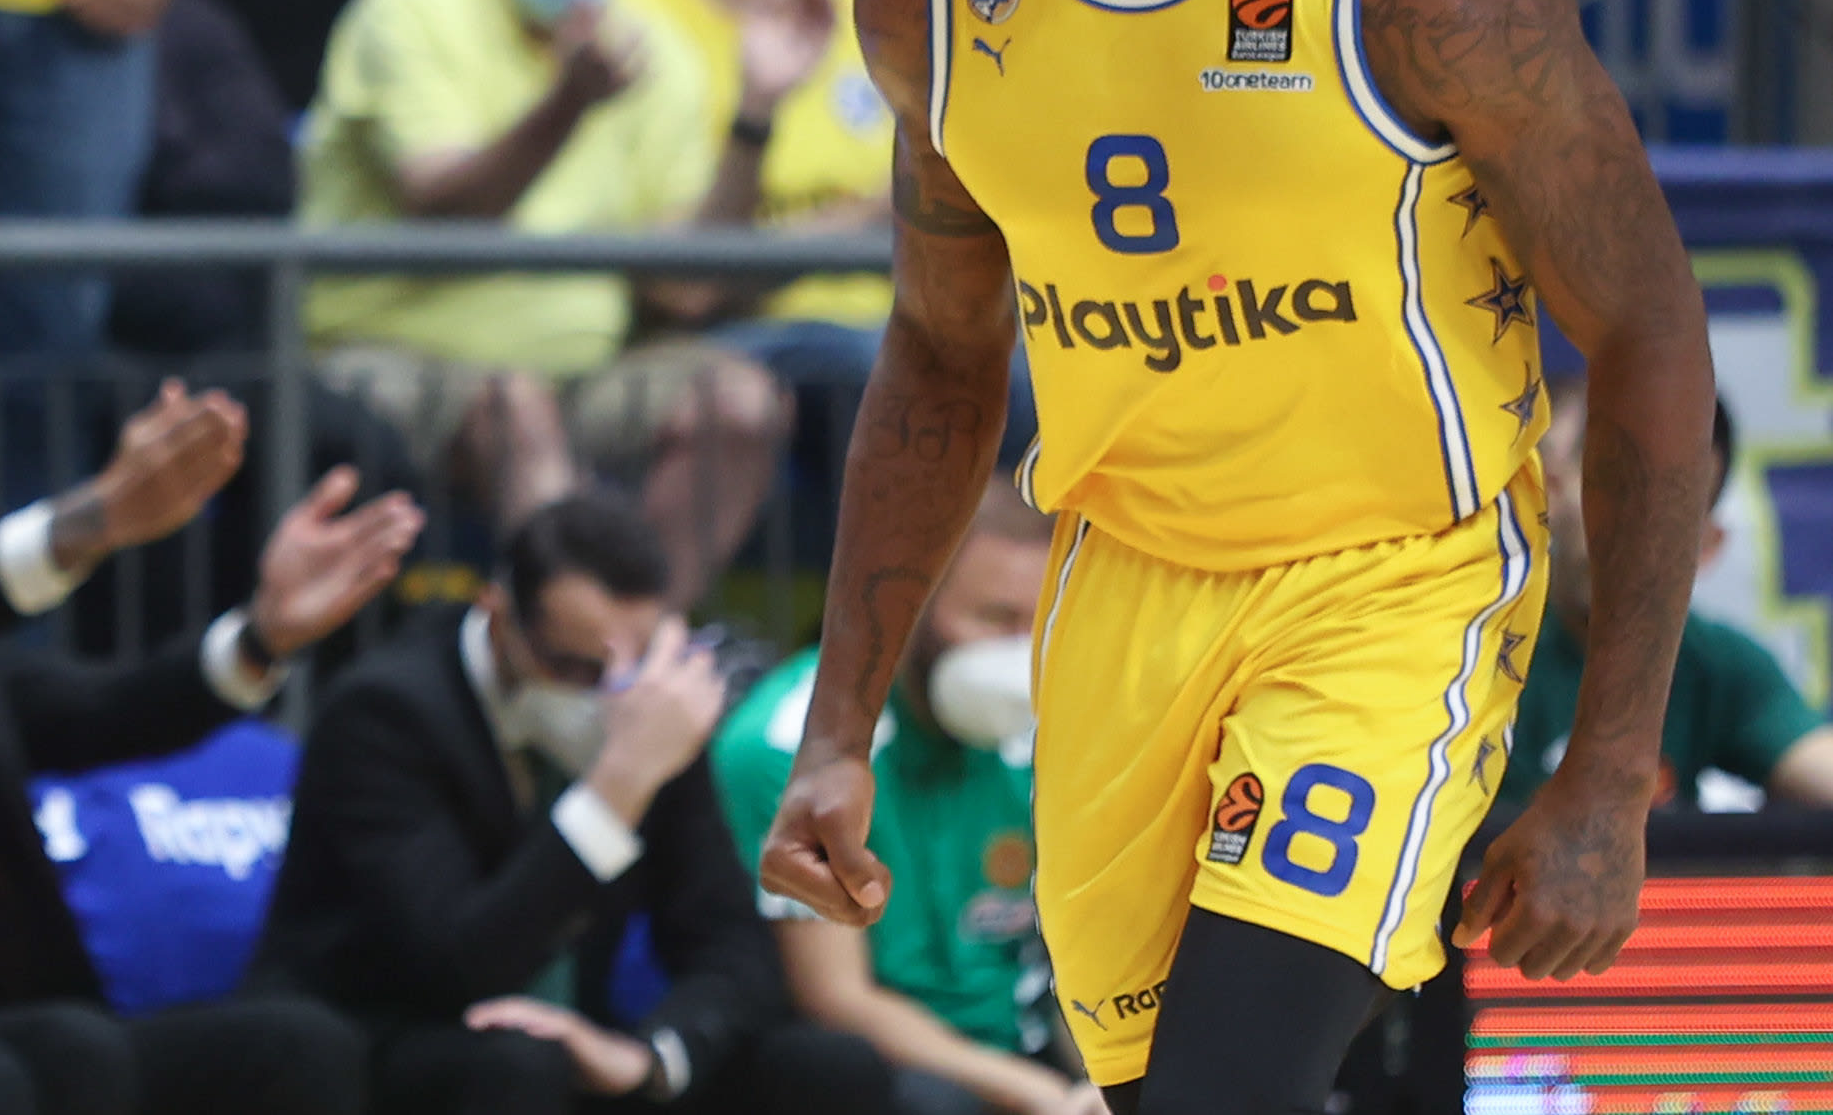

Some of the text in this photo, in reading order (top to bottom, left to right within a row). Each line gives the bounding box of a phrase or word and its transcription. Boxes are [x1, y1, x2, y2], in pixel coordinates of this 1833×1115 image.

[1085, 134, 1180, 254] 8
[1018, 273, 1358, 373] Playtika
[1261, 762, 1376, 898] 8
